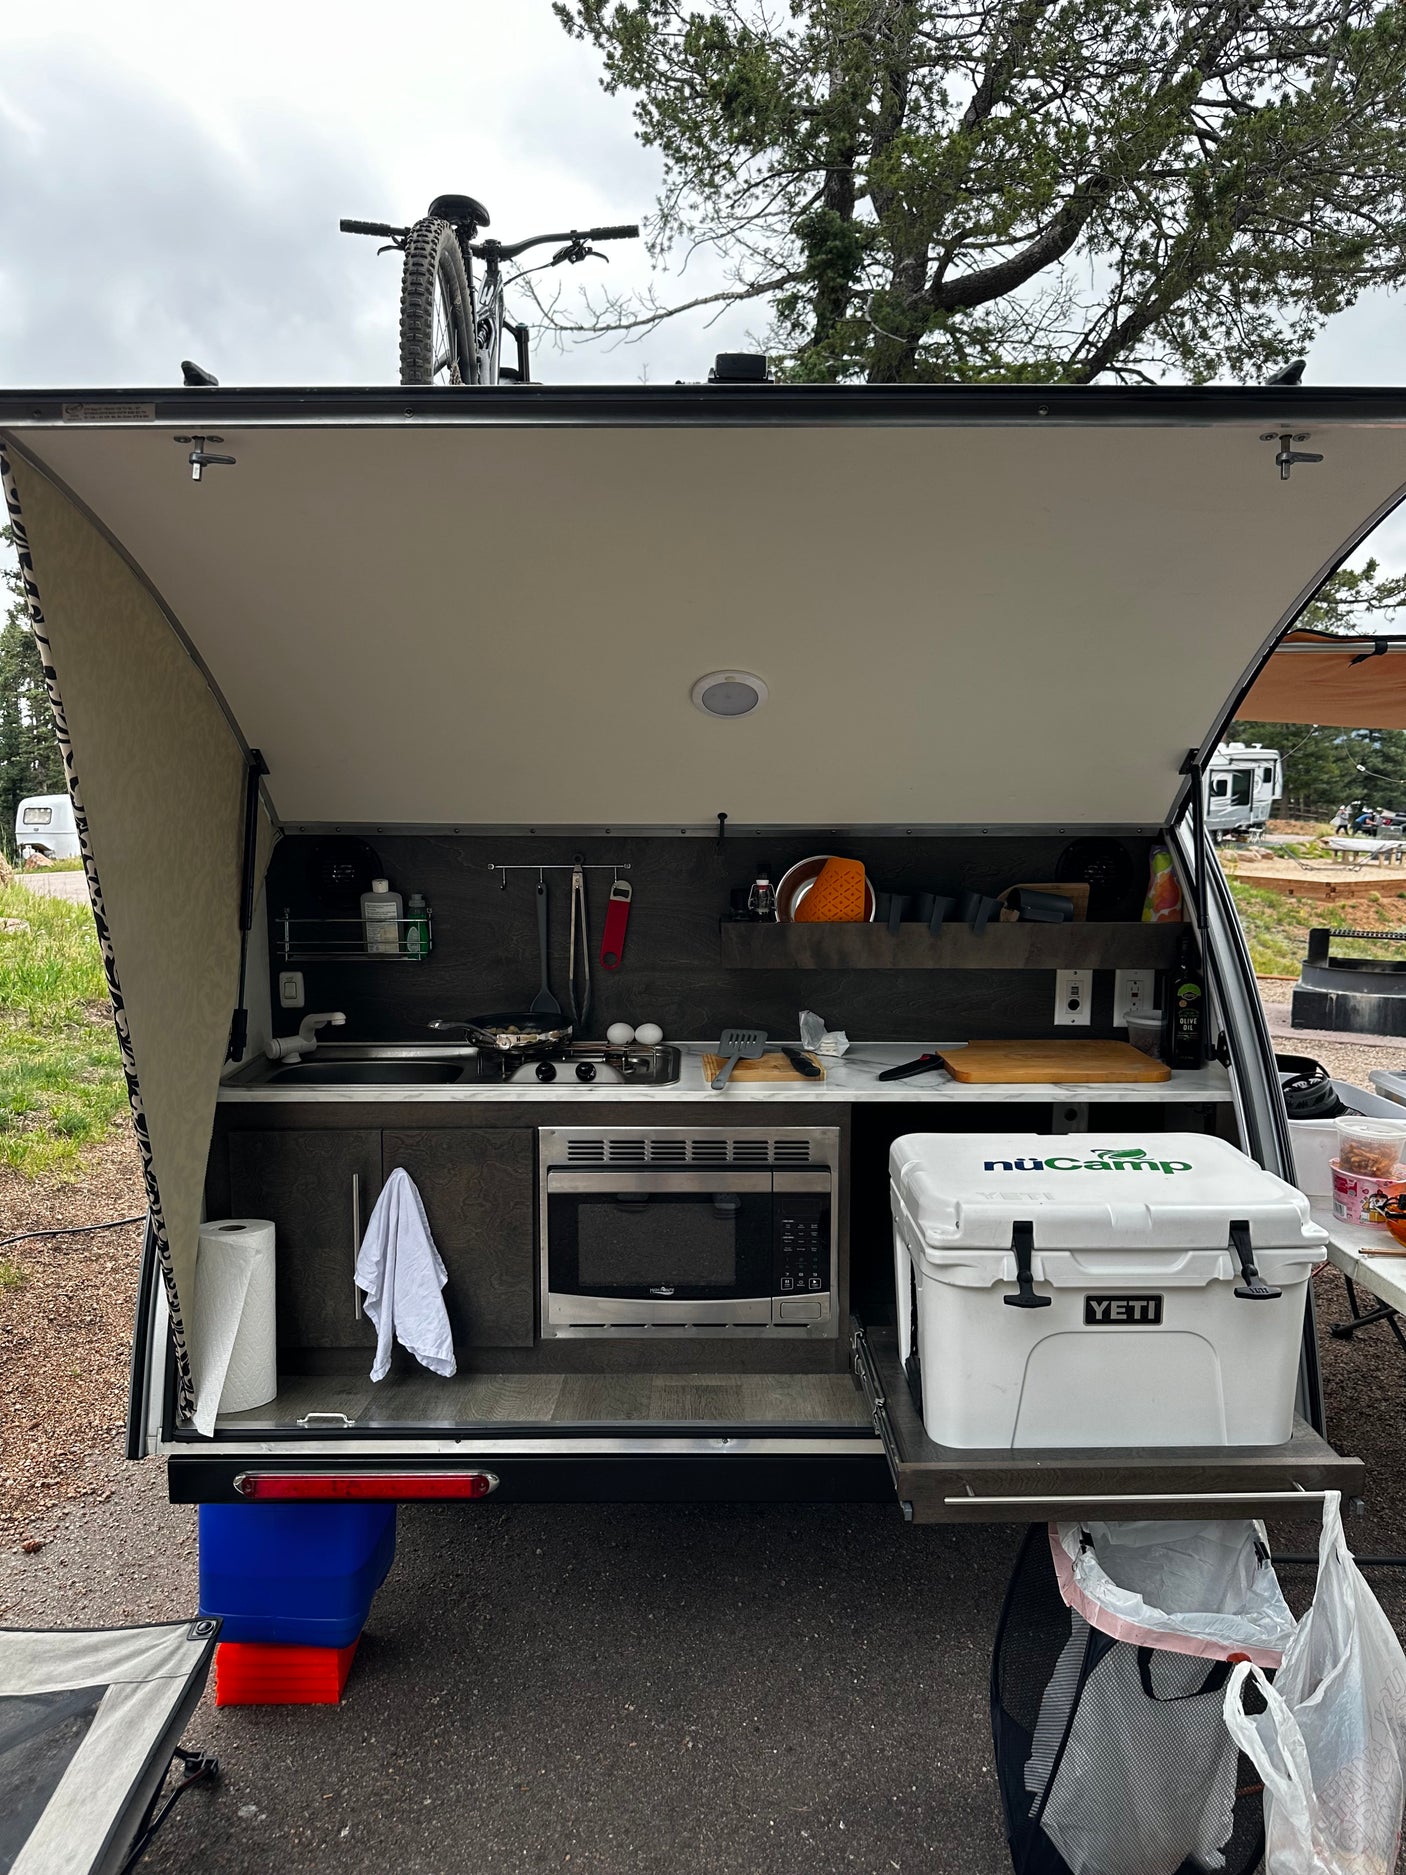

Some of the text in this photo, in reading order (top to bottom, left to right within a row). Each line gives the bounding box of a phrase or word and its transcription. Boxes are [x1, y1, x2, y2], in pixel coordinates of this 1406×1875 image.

[1179, 1017, 1197, 1025] OLIVE
[983, 1156, 1194, 1175] nüCamp
[974, 1191, 1057, 1201] YETI
[1089, 1300, 1156, 1320] YETI
